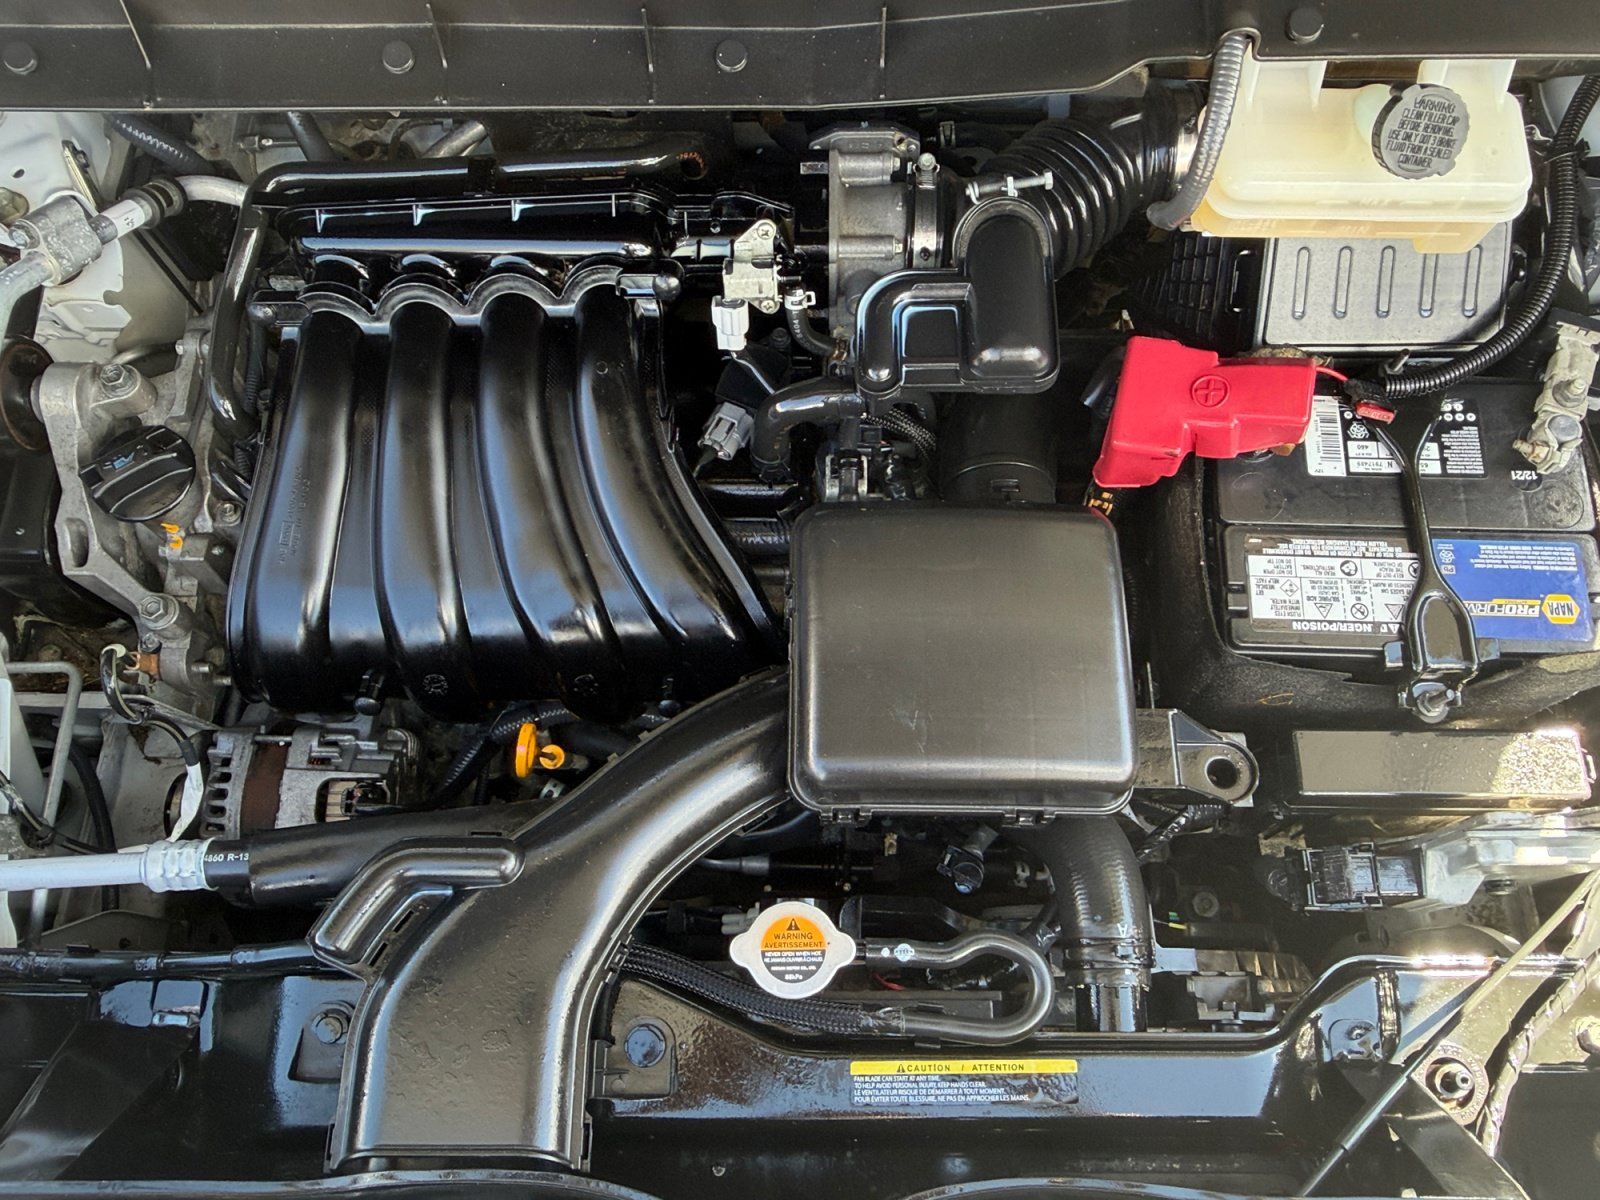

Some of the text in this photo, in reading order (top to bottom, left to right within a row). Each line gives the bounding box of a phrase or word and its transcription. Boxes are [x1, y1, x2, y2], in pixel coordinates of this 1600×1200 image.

[1402, 108, 1460, 126] CLEAN FILLER CAP
[1397, 118, 1422, 132] BEFORE
[1387, 129, 1457, 149] USE ONLY DOT 3 BRAKE
[1386, 139, 1407, 152] FLUID
[1406, 144, 1424, 156] FROM
[1428, 147, 1453, 159] SEALED
[1511, 470, 1538, 481] 12/21
[1547, 601, 1575, 617] NAPA
[1292, 621, 1389, 633] DNGER/POISON
[773, 932, 813, 940] WARNING
[1116, 922, 1128, 938] A
[764, 941, 824, 949] AVERTISSEMENT
[906, 1064, 951, 1072] CAUTION
[971, 1063, 1025, 1072] ATTENTION
[898, 1088, 919, 1096] RISQUE
[927, 1087, 958, 1095] DÉMARRER
